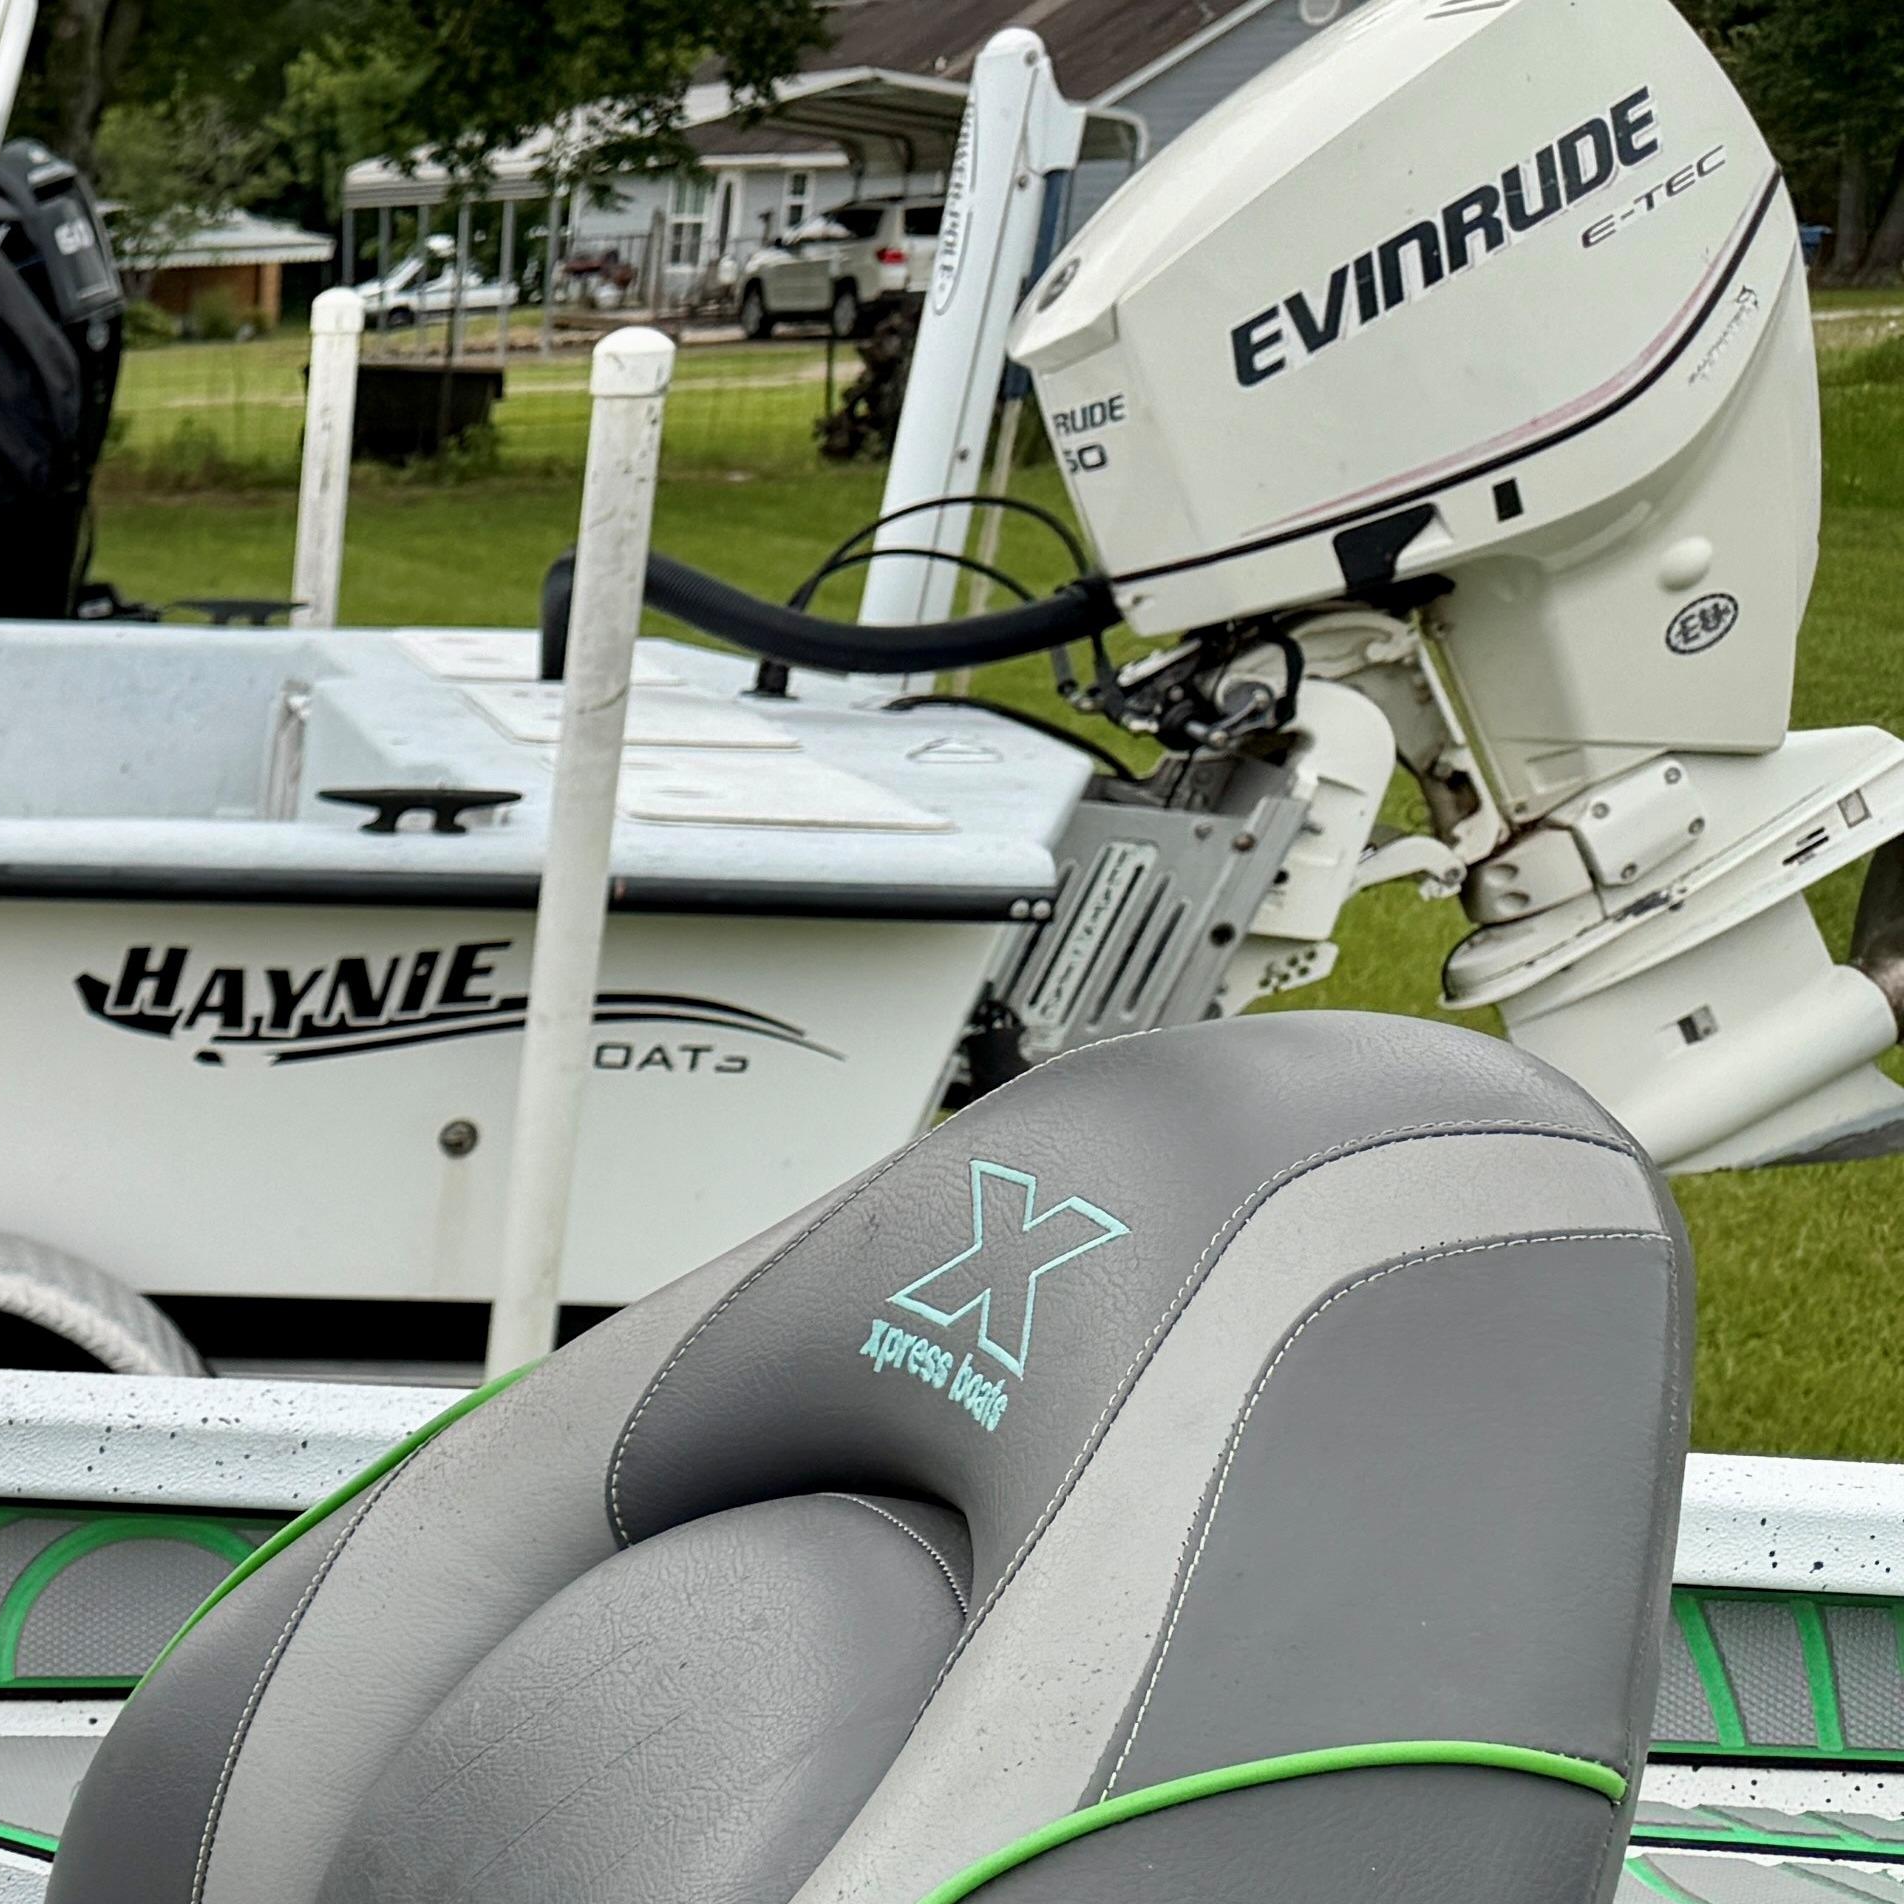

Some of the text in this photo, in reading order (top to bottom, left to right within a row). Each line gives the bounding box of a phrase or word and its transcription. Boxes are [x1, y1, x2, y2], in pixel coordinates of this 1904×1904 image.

[1229, 85, 1660, 388] EVINRUDE
[1581, 146, 1727, 250] E-TEC
[106, 939, 516, 1039] HAYNIE
